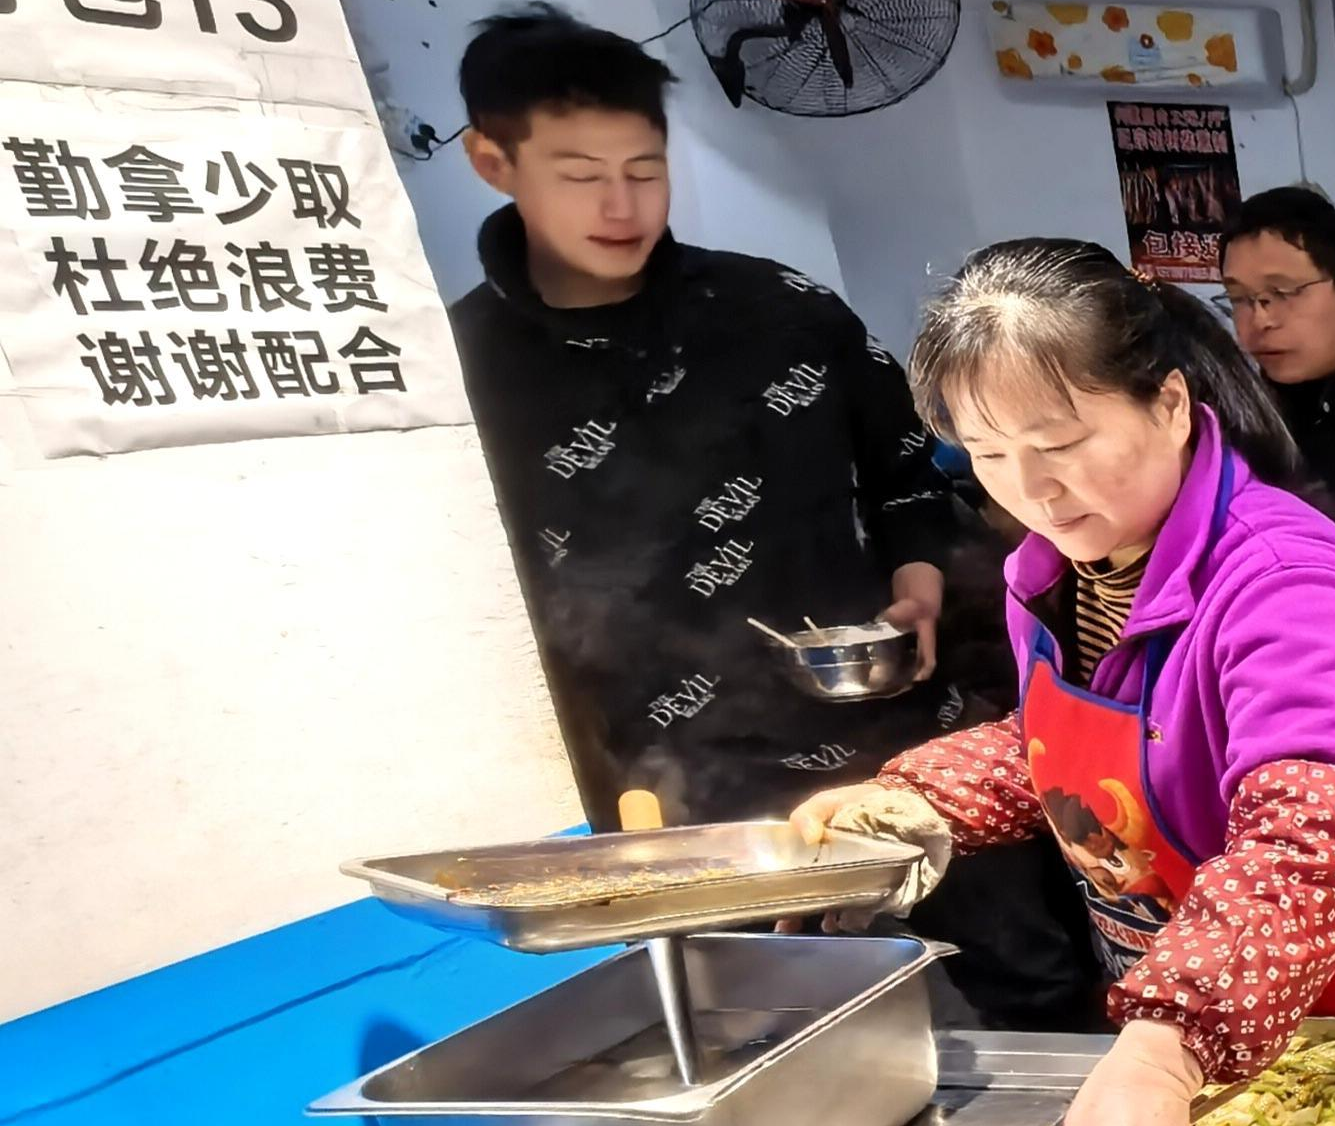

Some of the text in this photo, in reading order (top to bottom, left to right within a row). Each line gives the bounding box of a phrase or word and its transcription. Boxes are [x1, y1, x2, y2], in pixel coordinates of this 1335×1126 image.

[2, 136, 362, 229] 勤拿少取
[45, 236, 389, 316] 杜绝浪费
[76, 326, 408, 406] 谢谢配合
[765, 362, 828, 417] DEVIL
[546, 419, 618, 479] DEVIL
[697, 476, 763, 533] DEVIL
[688, 538, 755, 598] DEVIL
[648, 673, 722, 728] DEVIL
